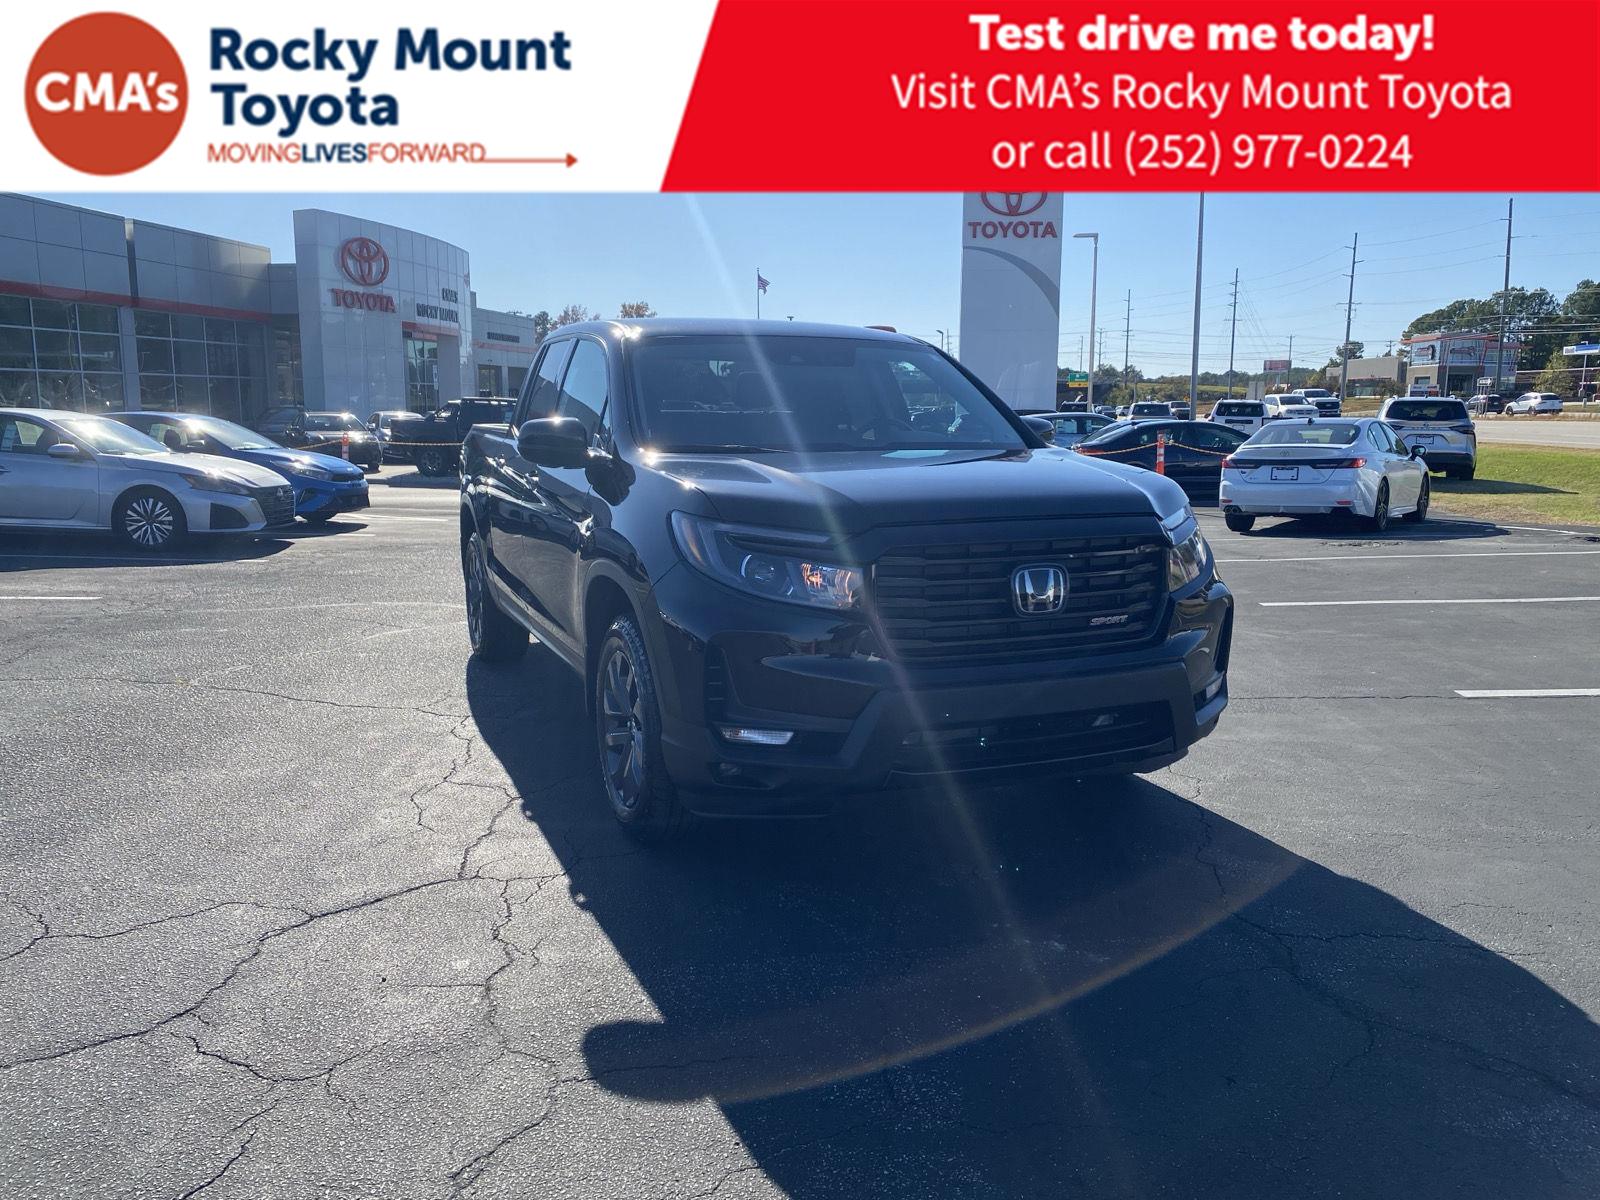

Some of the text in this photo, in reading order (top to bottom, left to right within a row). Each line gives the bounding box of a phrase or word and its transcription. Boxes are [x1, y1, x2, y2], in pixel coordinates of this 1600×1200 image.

[968, 221, 1058, 239] TOYOTA
[331, 288, 397, 313] TOYOTA
[1090, 614, 1129, 626] SPORT
